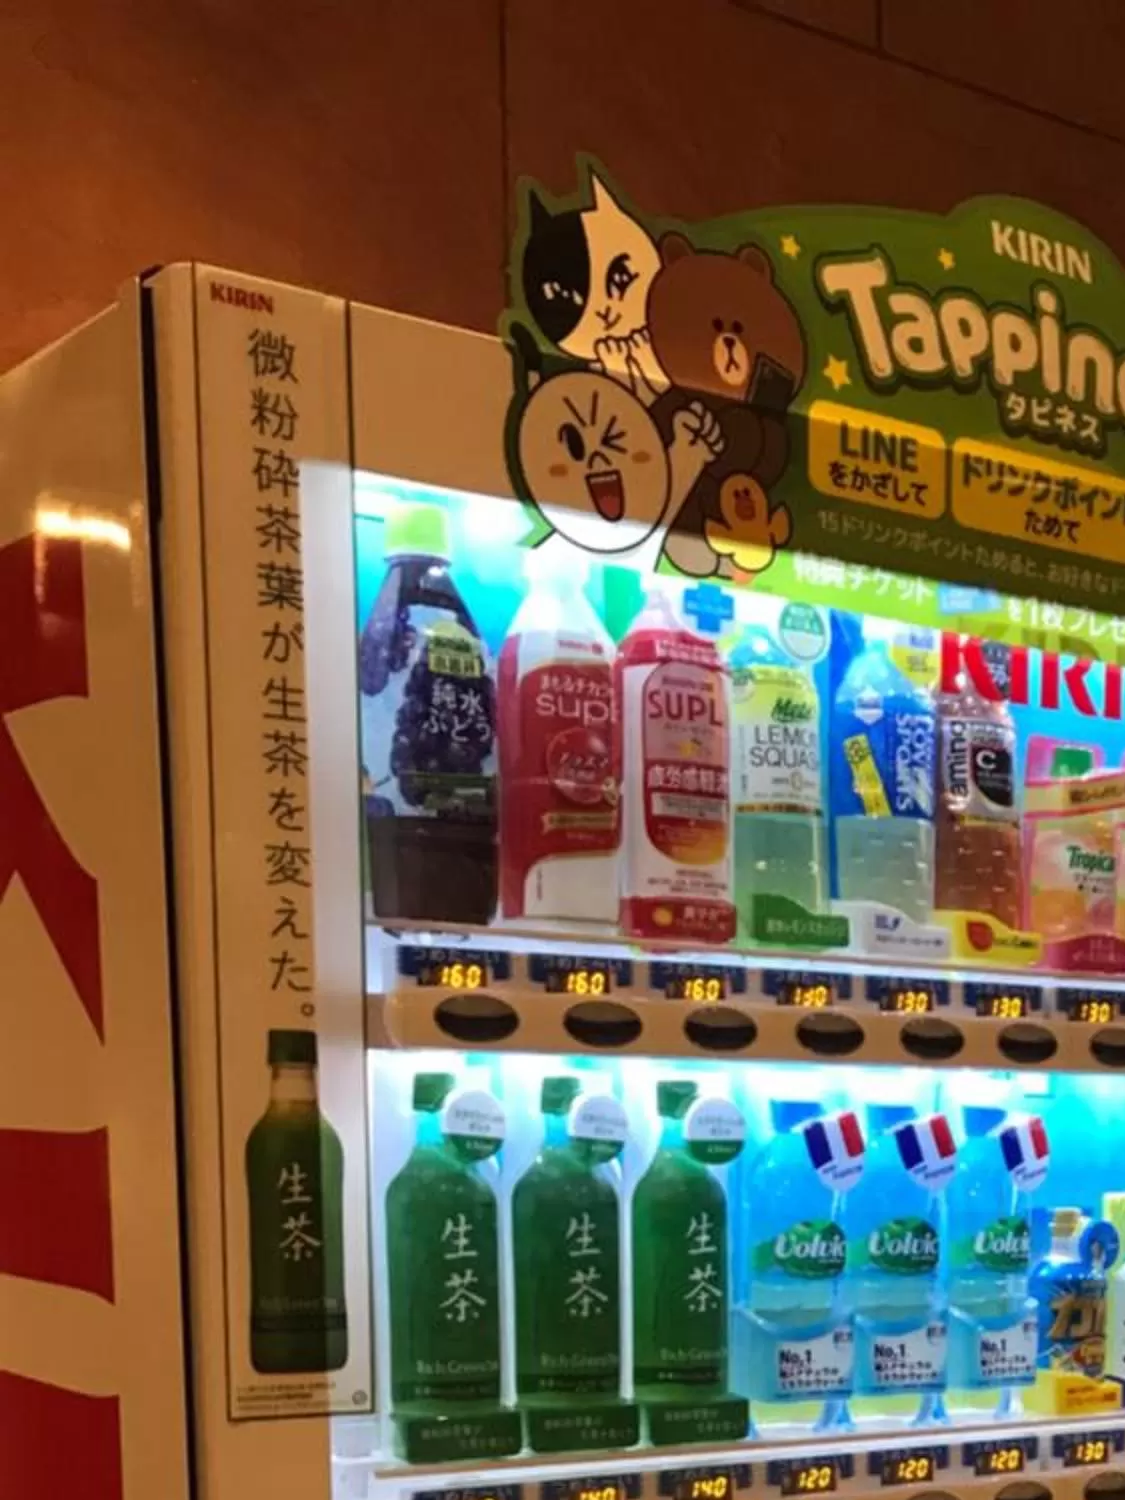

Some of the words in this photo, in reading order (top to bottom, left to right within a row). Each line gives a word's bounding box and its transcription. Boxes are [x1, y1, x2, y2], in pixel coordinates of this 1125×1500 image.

[990, 219, 1093, 285] KIRIN
[209, 280, 275, 316] KIRIN
[1005, 392, 1101, 445] タピネス
[838, 422, 919, 473] LINE
[827, 463, 930, 507] をかざして
[1023, 509, 1082, 545] ためて
[246, 327, 316, 1018] 微粉砕茶葉が生茶を変えた。
[441, 963, 482, 990] 160
[567, 971, 606, 995] 160
[684, 978, 721, 1002] 160
[991, 996, 1023, 1020] 130
[276, 1161, 322, 1262] 生茶
[439, 1213, 487, 1323] 生茶
[563, 1211, 609, 1319] 生茶
[683, 1210, 724, 1314] 生茶
[778, 1349, 814, 1371] No.1
[798, 1467, 832, 1490] 120
[897, 1457, 931, 1480] 120
[989, 1449, 1021, 1472] 120
[692, 1475, 728, 1499] 140
